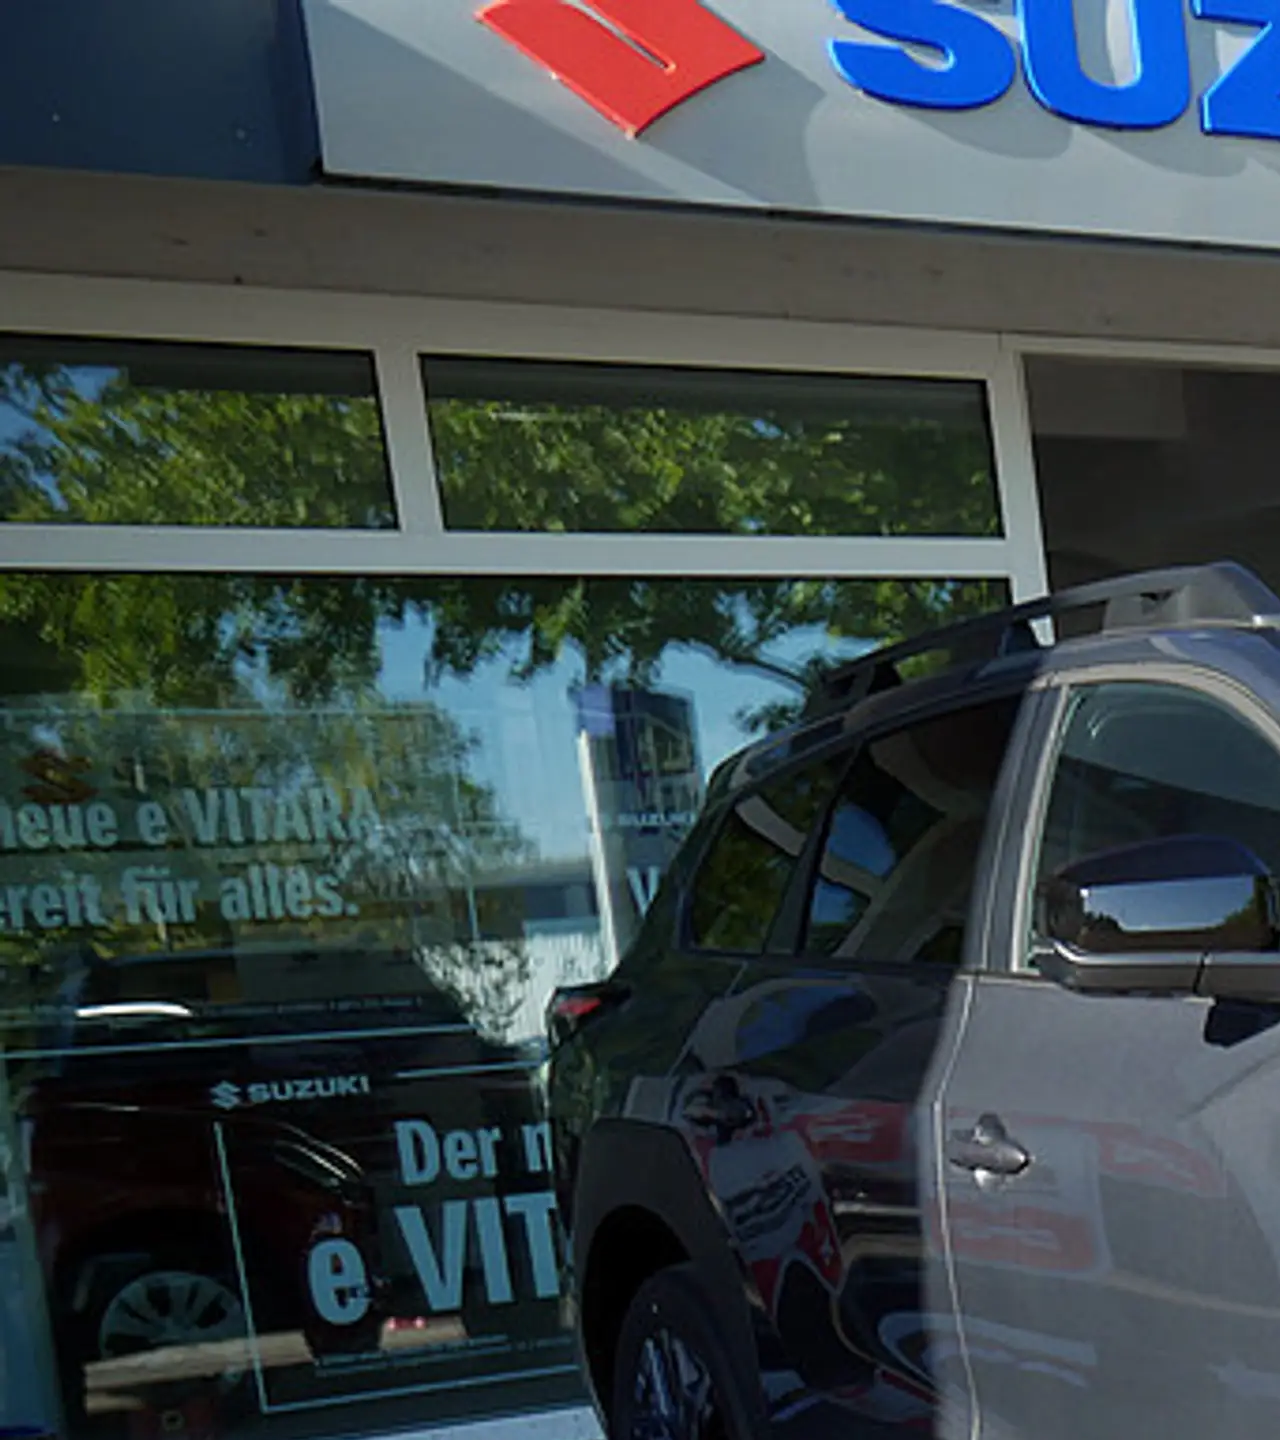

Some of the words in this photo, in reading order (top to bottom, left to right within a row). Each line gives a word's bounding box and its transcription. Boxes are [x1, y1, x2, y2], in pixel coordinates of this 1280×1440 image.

[137, 802, 169, 845] e
[182, 786, 382, 844] VITARA
[121, 865, 199, 924] für
[246, 1075, 370, 1101] SUZUKI
[394, 1119, 503, 1186] Der
[307, 1236, 372, 1326] e
